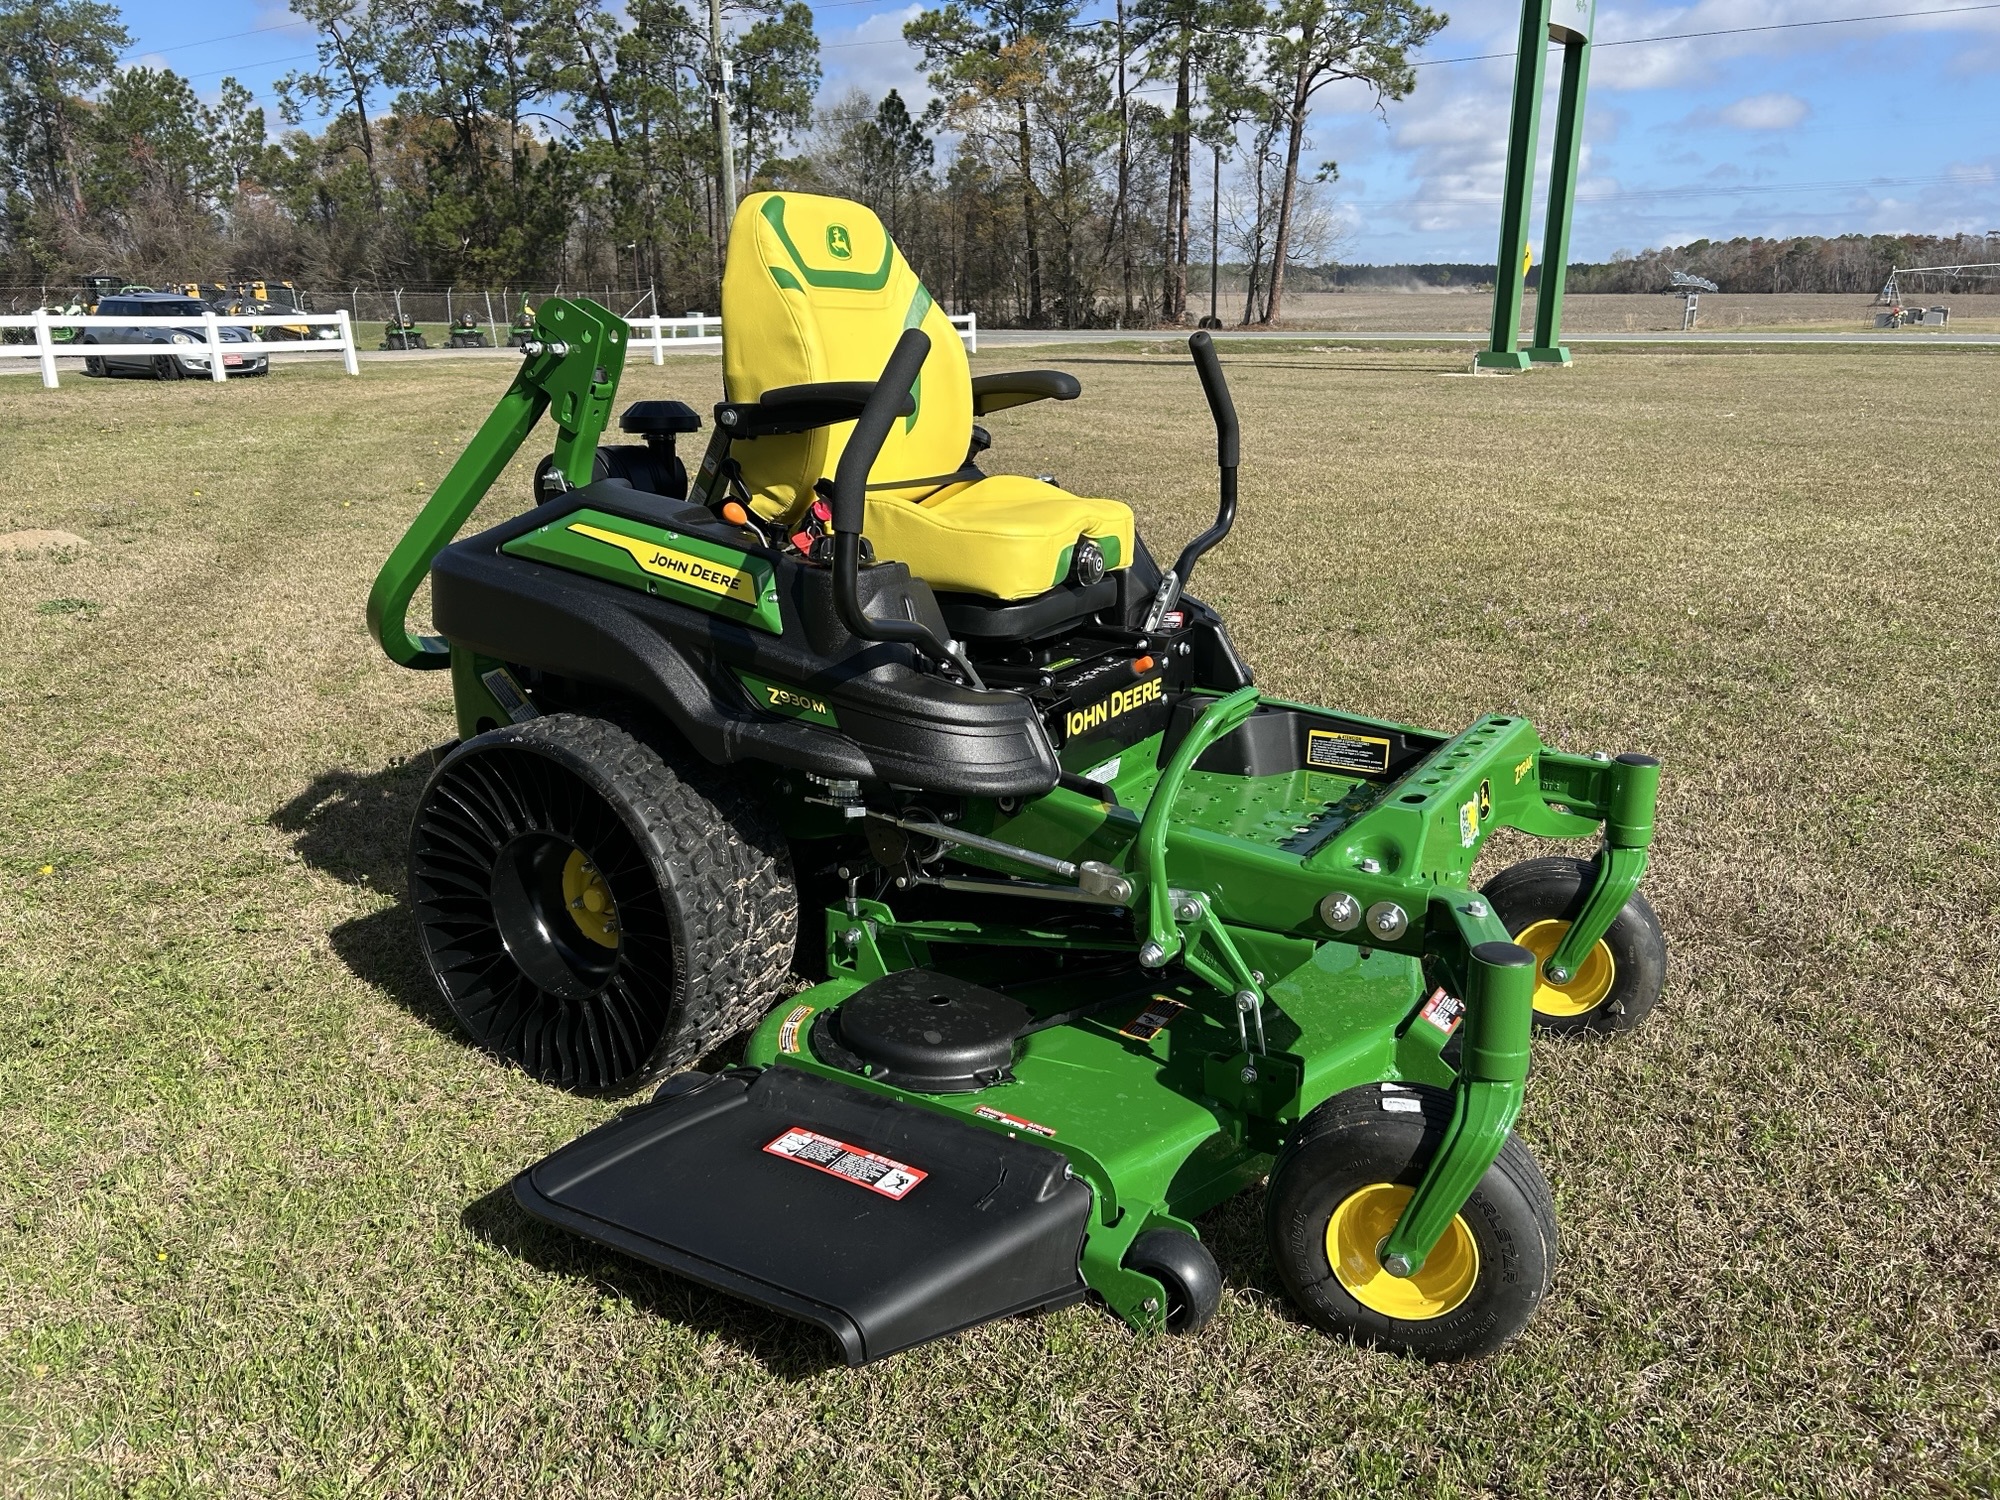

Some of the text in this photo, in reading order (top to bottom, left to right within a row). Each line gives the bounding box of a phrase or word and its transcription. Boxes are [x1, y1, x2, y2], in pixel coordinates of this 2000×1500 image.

[649, 552, 742, 591] JOHN DEERE
[766, 686, 827, 715] Z930M
[1066, 677, 1162, 739] JOHN DEERE
[812, 1133, 844, 1149] DANGER
[874, 1153, 910, 1173] PELIGRO
